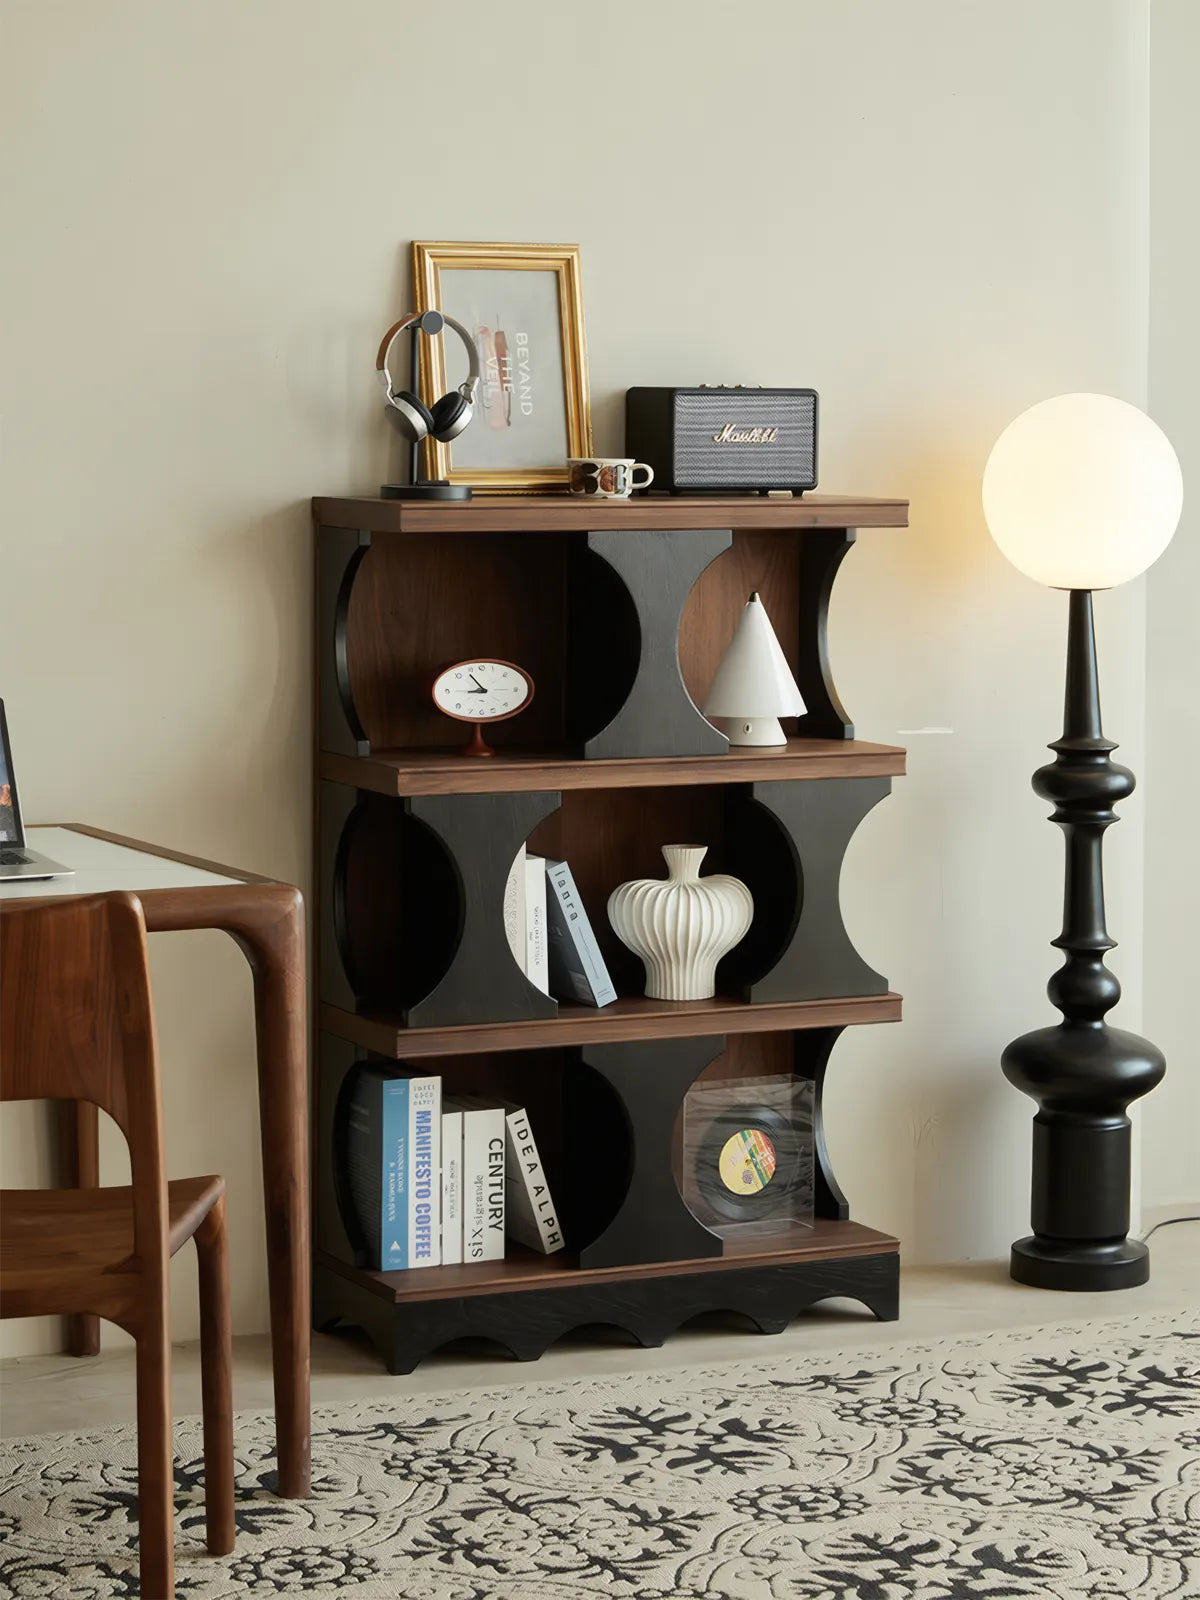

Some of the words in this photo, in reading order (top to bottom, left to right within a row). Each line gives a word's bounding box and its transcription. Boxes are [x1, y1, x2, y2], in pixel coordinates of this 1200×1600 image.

[485, 356, 499, 398] VEIL
[500, 354, 515, 394] THE
[516, 332, 533, 416] BEYAND
[415, 1110, 432, 1200] MANIFESTO
[488, 1138, 504, 1231] CENTURY
[514, 1118, 539, 1174] IDEA
[533, 1185, 561, 1245] ALPH
[415, 1203, 431, 1260] COFFEE
